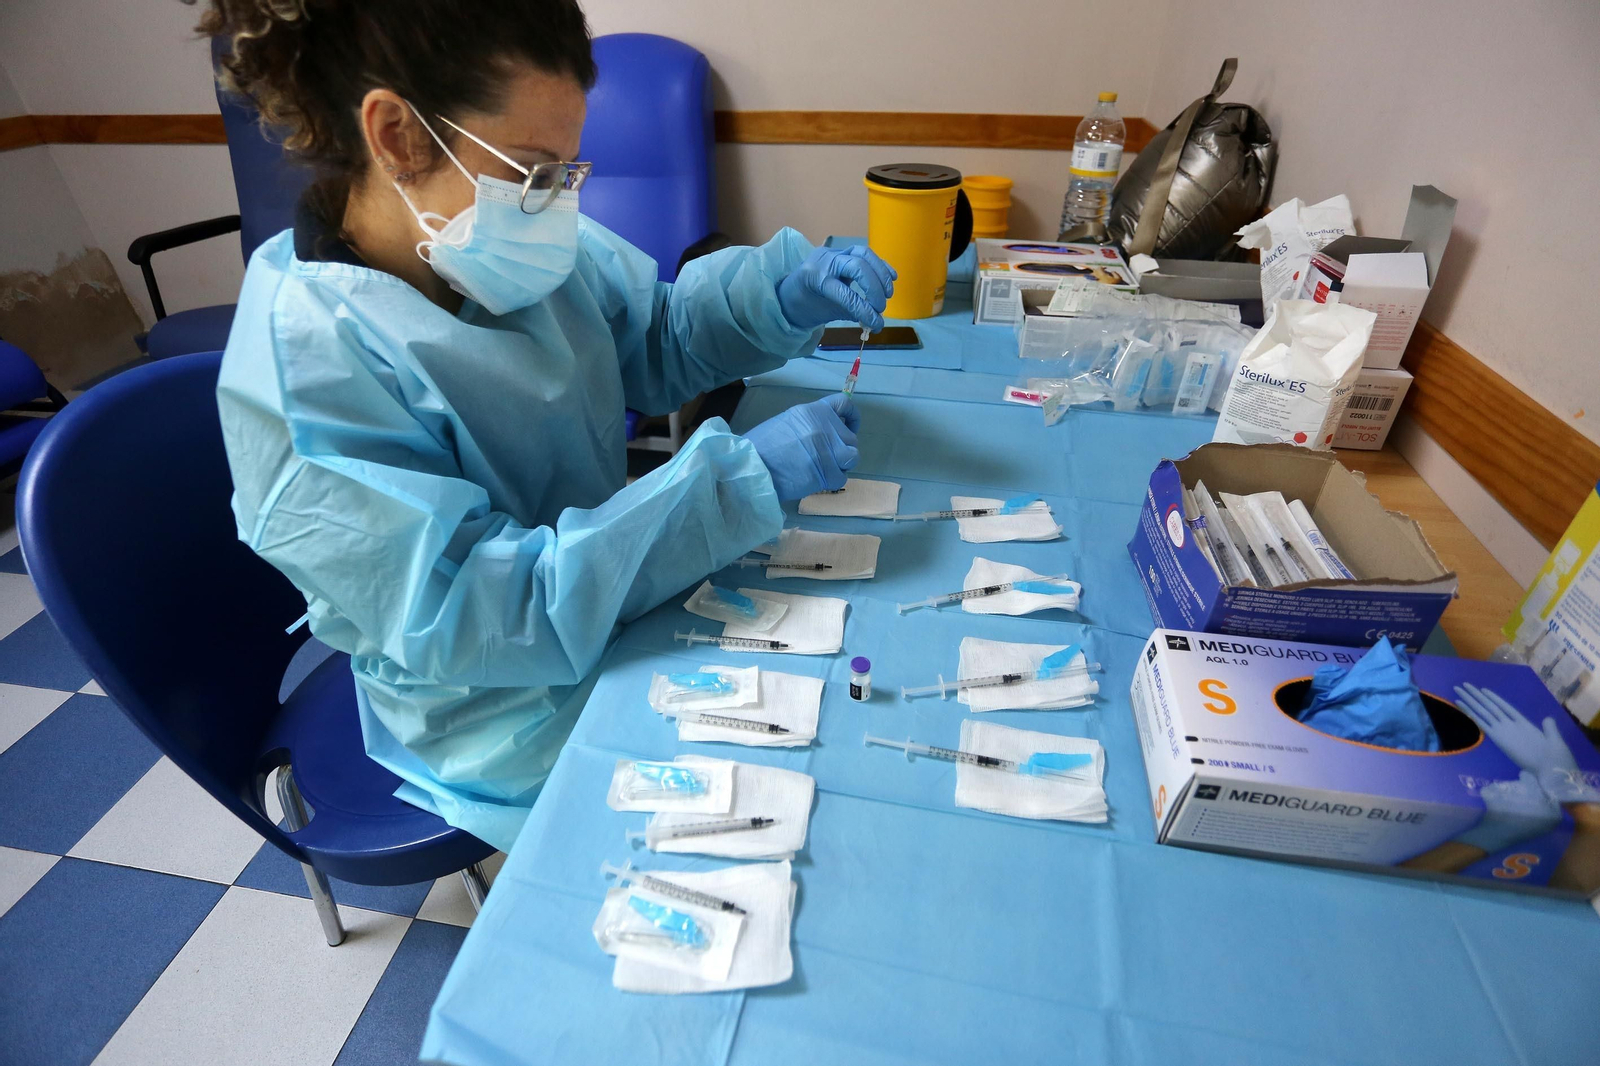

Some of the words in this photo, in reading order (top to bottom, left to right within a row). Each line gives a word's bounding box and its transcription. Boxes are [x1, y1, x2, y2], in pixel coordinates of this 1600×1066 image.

[1278, 242, 1288, 256] ES
[1289, 380, 1307, 394] ES
[1200, 639, 1328, 662] MEDIGUARD
[1206, 656, 1231, 666] AQL
[1234, 657, 1249, 666] 1.0
[1198, 678, 1237, 716] S
[1152, 664, 1172, 727] MEDIGUARD
[1167, 728, 1181, 760] BLUE
[1224, 740, 1266, 750] POWDER-FREE
[1268, 743, 1284, 751] EXAM
[1208, 759, 1223, 767] 200
[1231, 761, 1260, 772] SMALL
[1268, 765, 1276, 774] S
[1155, 784, 1166, 820] S
[1229, 789, 1363, 816] MEDIGUARD
[1366, 808, 1428, 824] BLUE
[1492, 853, 1540, 879] S
